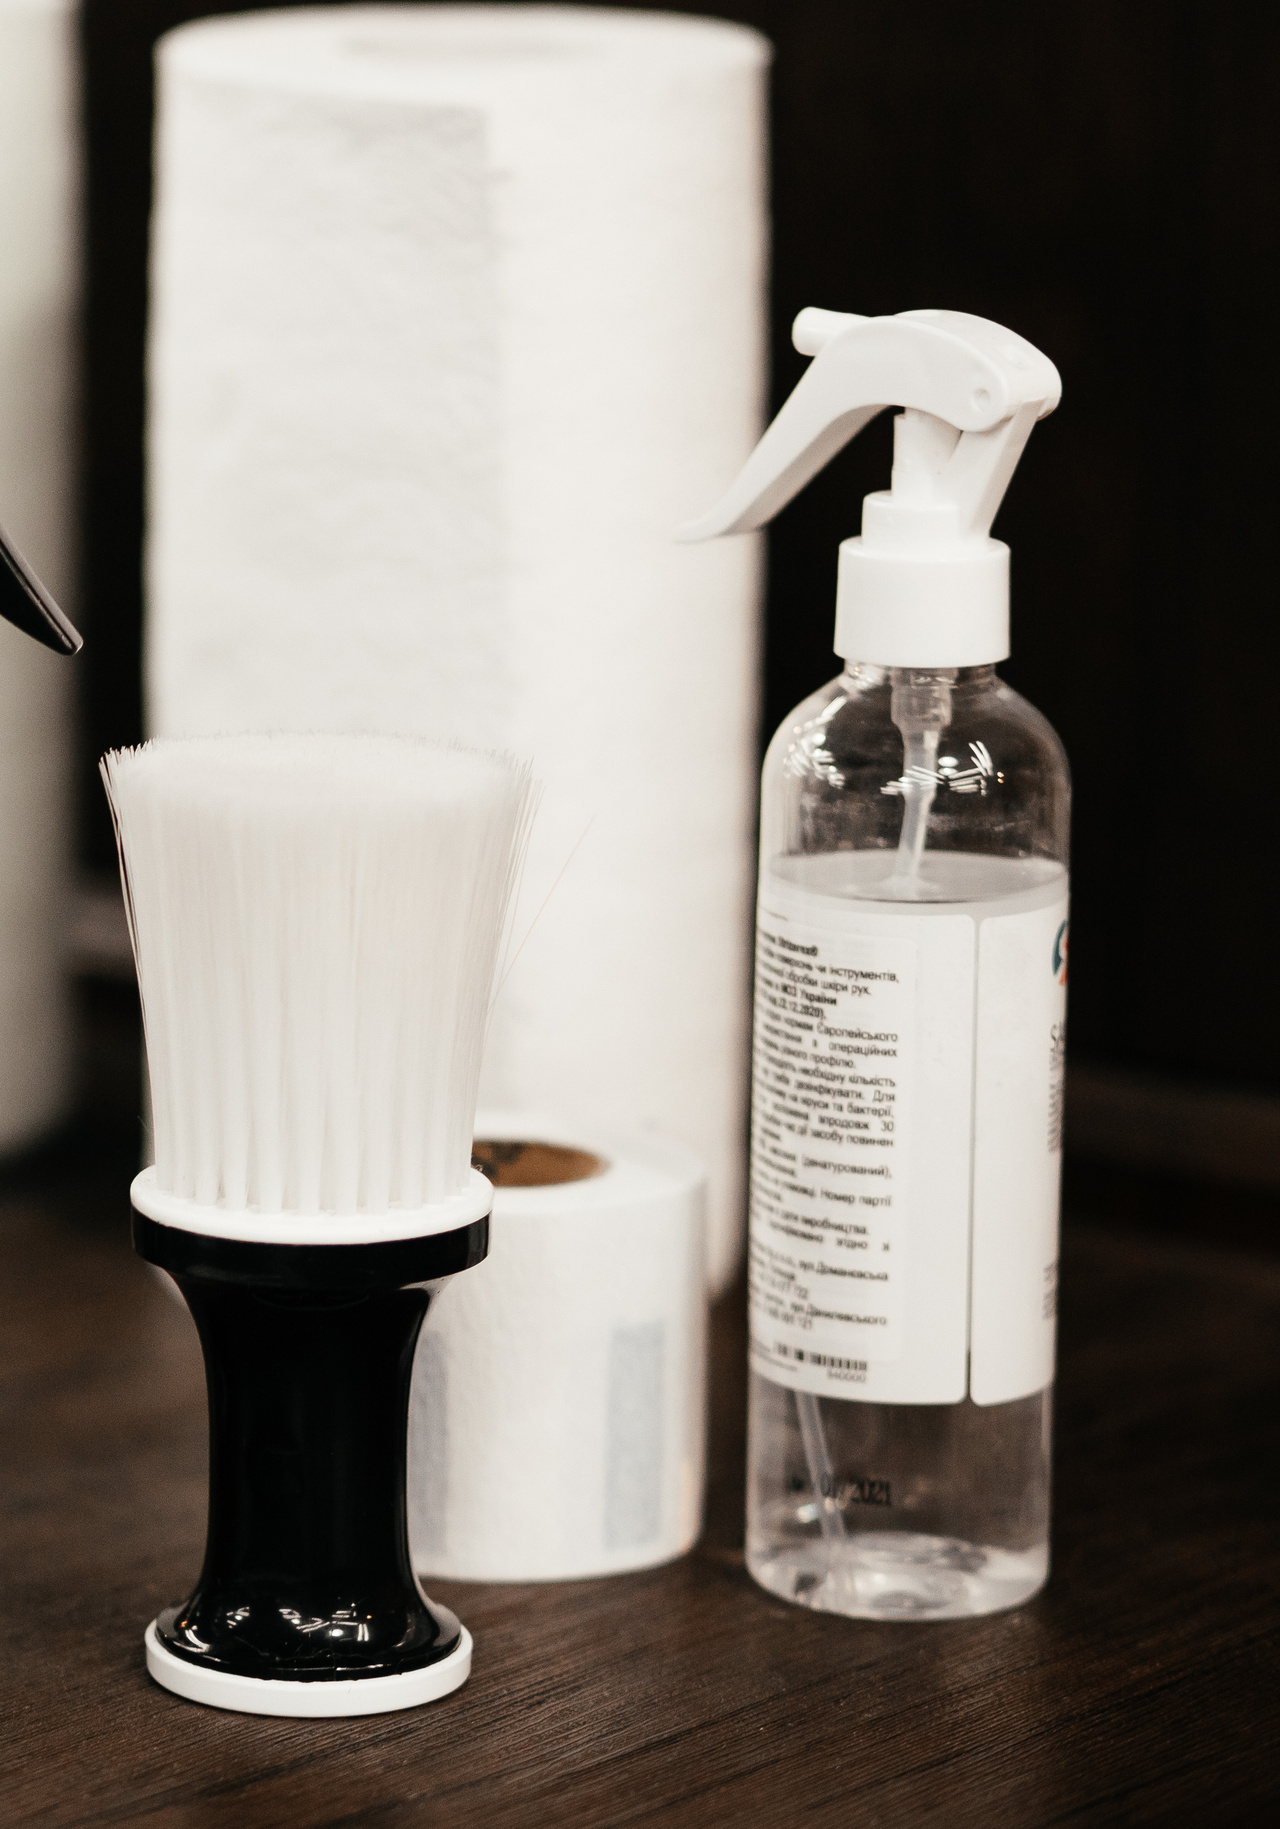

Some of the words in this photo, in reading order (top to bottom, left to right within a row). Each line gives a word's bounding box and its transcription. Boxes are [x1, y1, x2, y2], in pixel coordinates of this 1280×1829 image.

[829, 964, 899, 983] інструментів,
[851, 985, 871, 998] рук.
[829, 1041, 897, 1057] операційних
[872, 1089, 895, 1103] Для
[881, 1120, 894, 1132] 30
